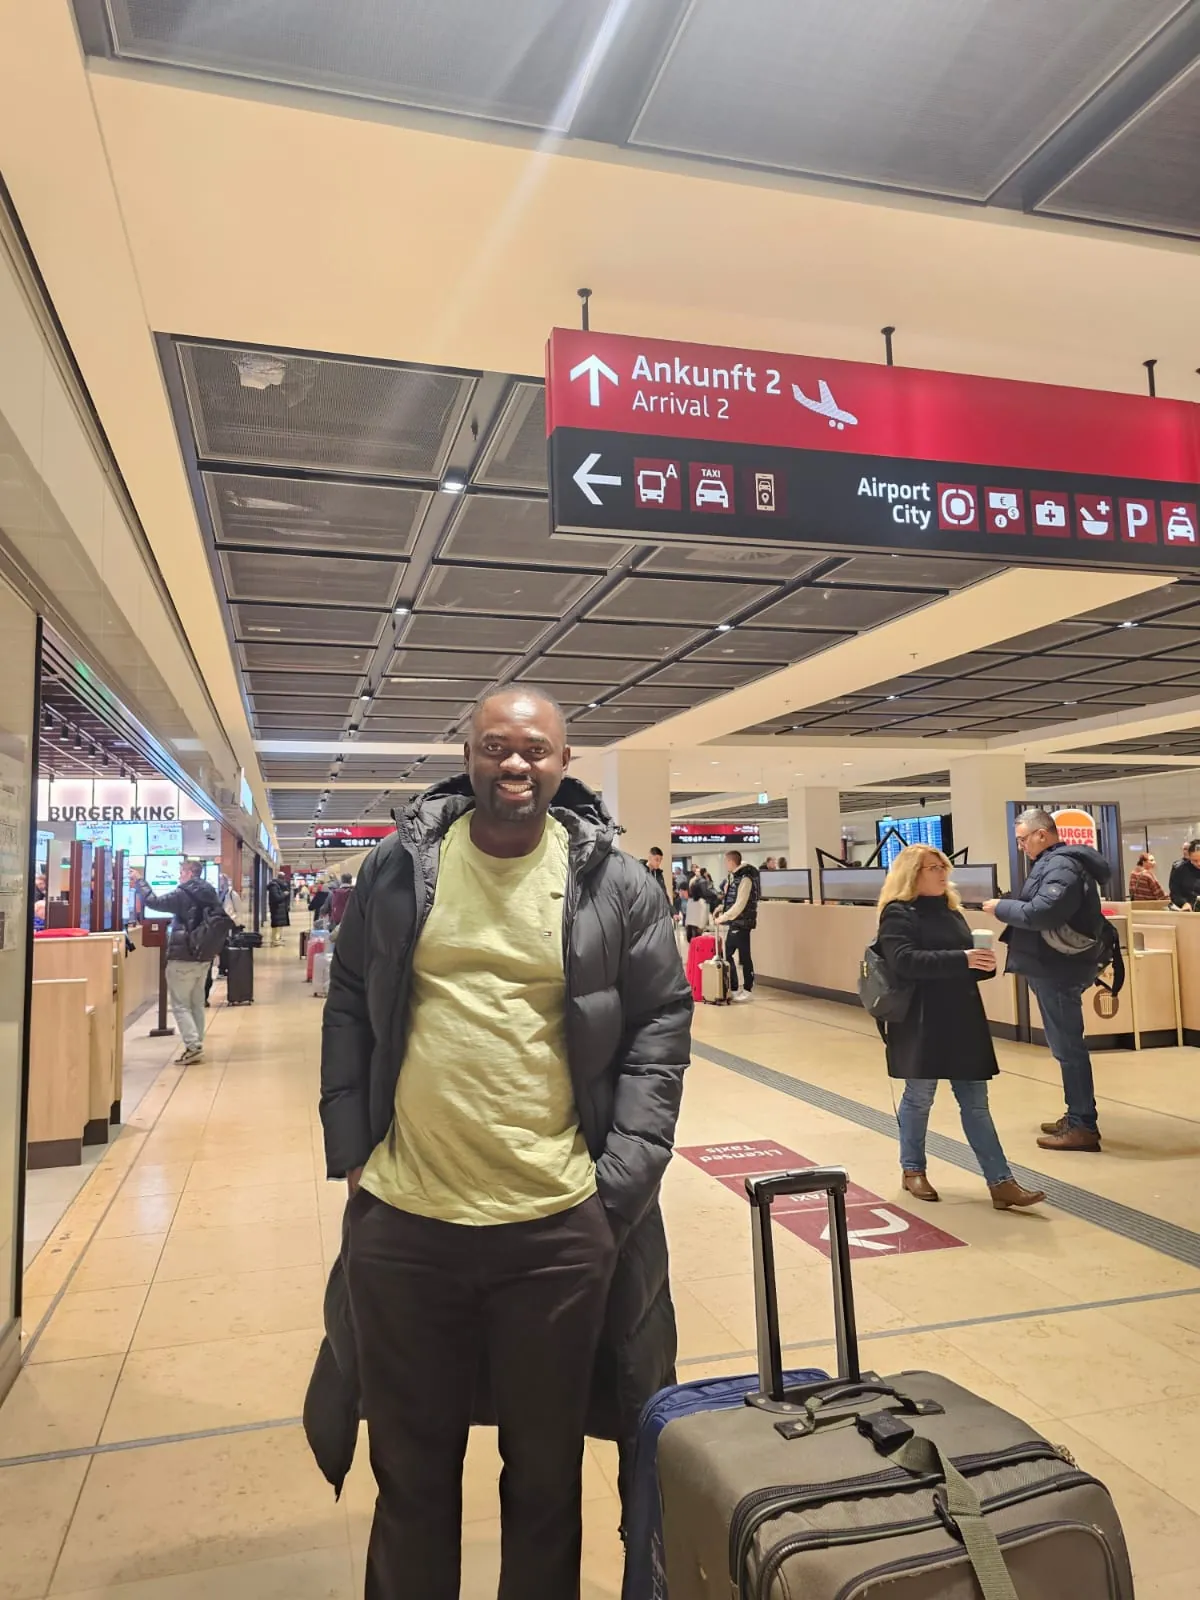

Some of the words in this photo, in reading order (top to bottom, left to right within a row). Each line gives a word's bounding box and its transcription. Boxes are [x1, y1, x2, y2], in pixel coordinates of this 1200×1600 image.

[631, 355, 757, 393] Ankunft
[765, 369, 781, 395] 2
[632, 390, 710, 418] Arrival
[717, 398, 730, 420] 2
[665, 463, 678, 479] A
[700, 468, 721, 478] TAXI
[857, 477, 931, 503] Airport
[892, 504, 931, 531] City
[1125, 502, 1148, 538] P
[49, 806, 124, 821] BURGER
[130, 806, 175, 821] KING
[1057, 827, 1094, 839] URGER
[699, 1148, 784, 1163] Licensed
[705, 1144, 756, 1154] Taxis
